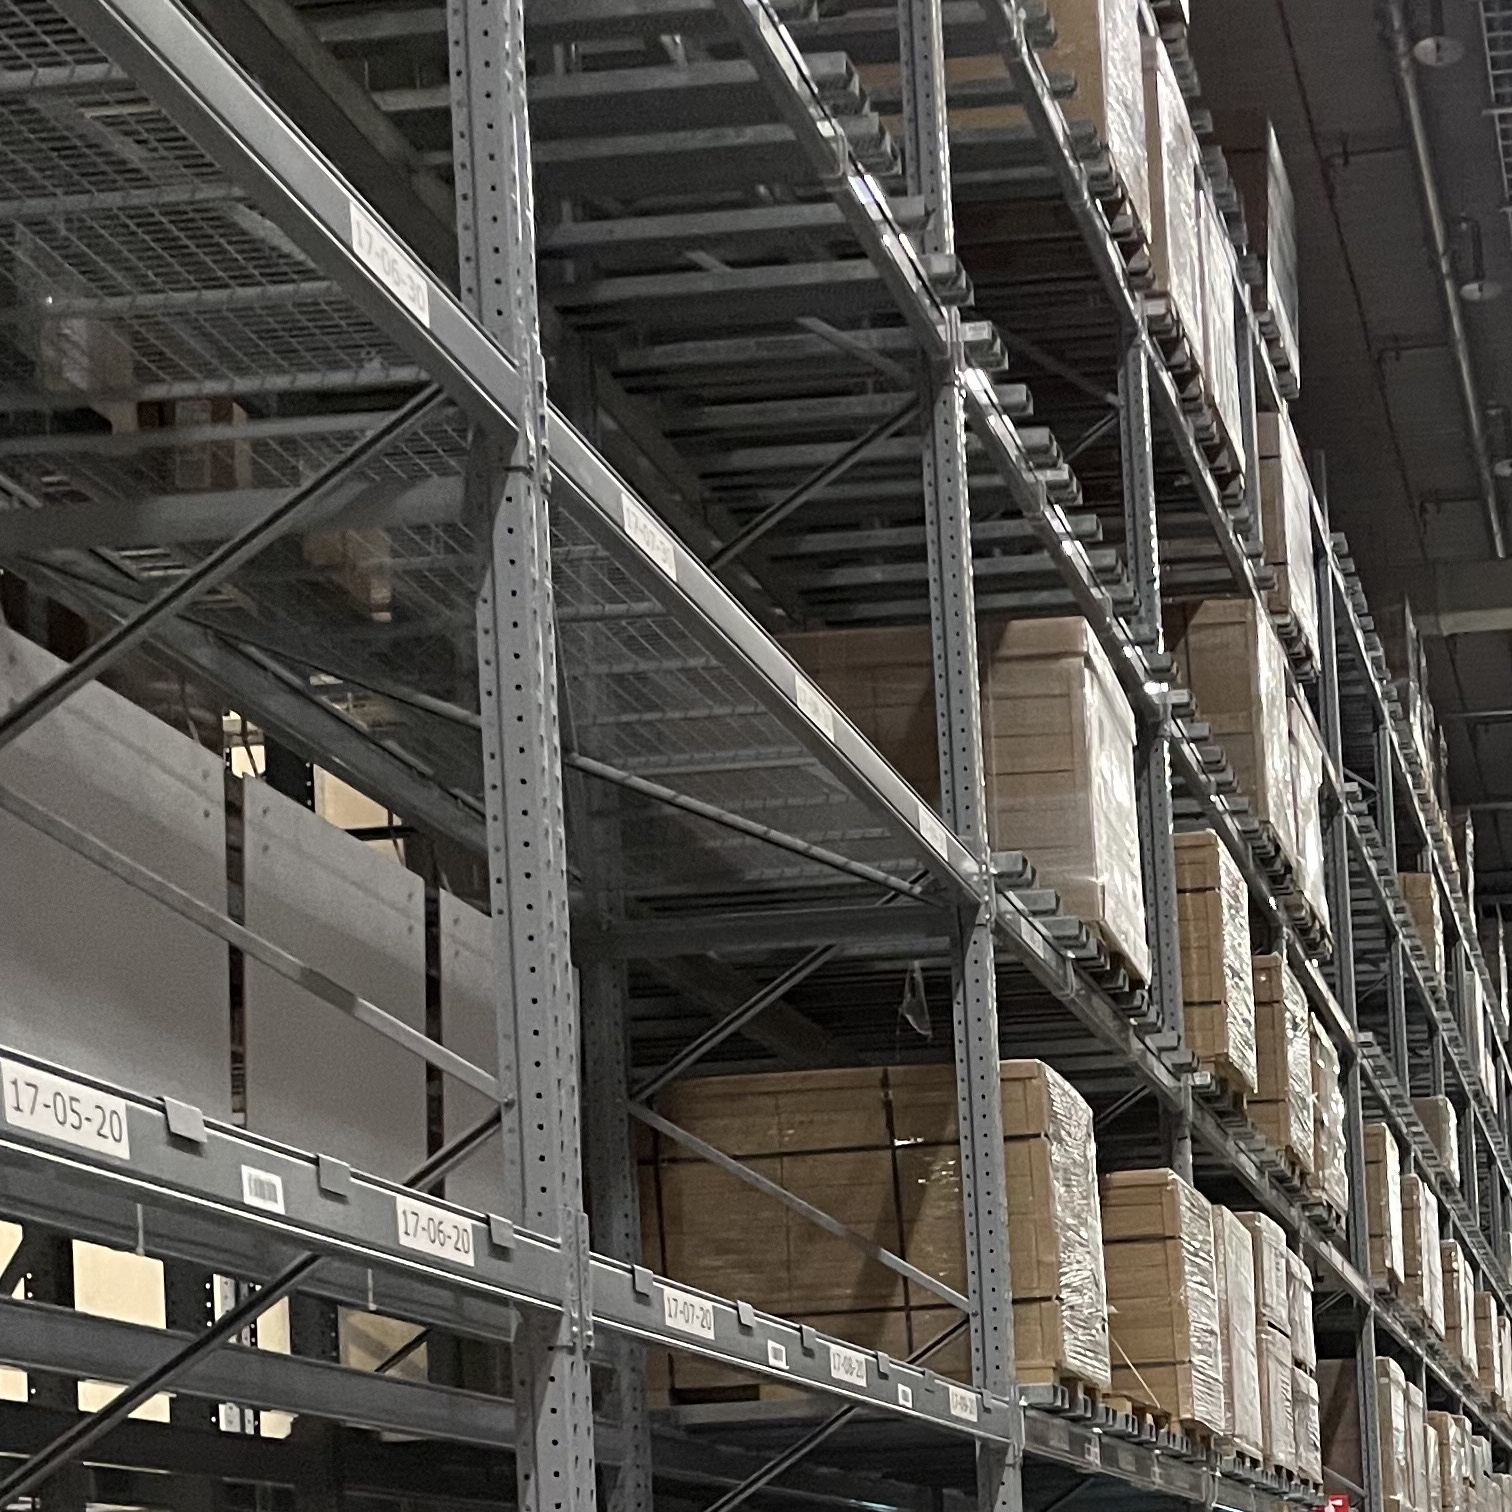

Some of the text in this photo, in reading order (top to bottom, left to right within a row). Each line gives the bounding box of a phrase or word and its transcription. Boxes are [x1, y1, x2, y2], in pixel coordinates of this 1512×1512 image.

[356, 220, 425, 311] 17-06-30
[11, 1078, 122, 1143] 17-05-20
[402, 1209, 470, 1254] 17-06-20
[667, 1297, 711, 1330] 17-07-20
